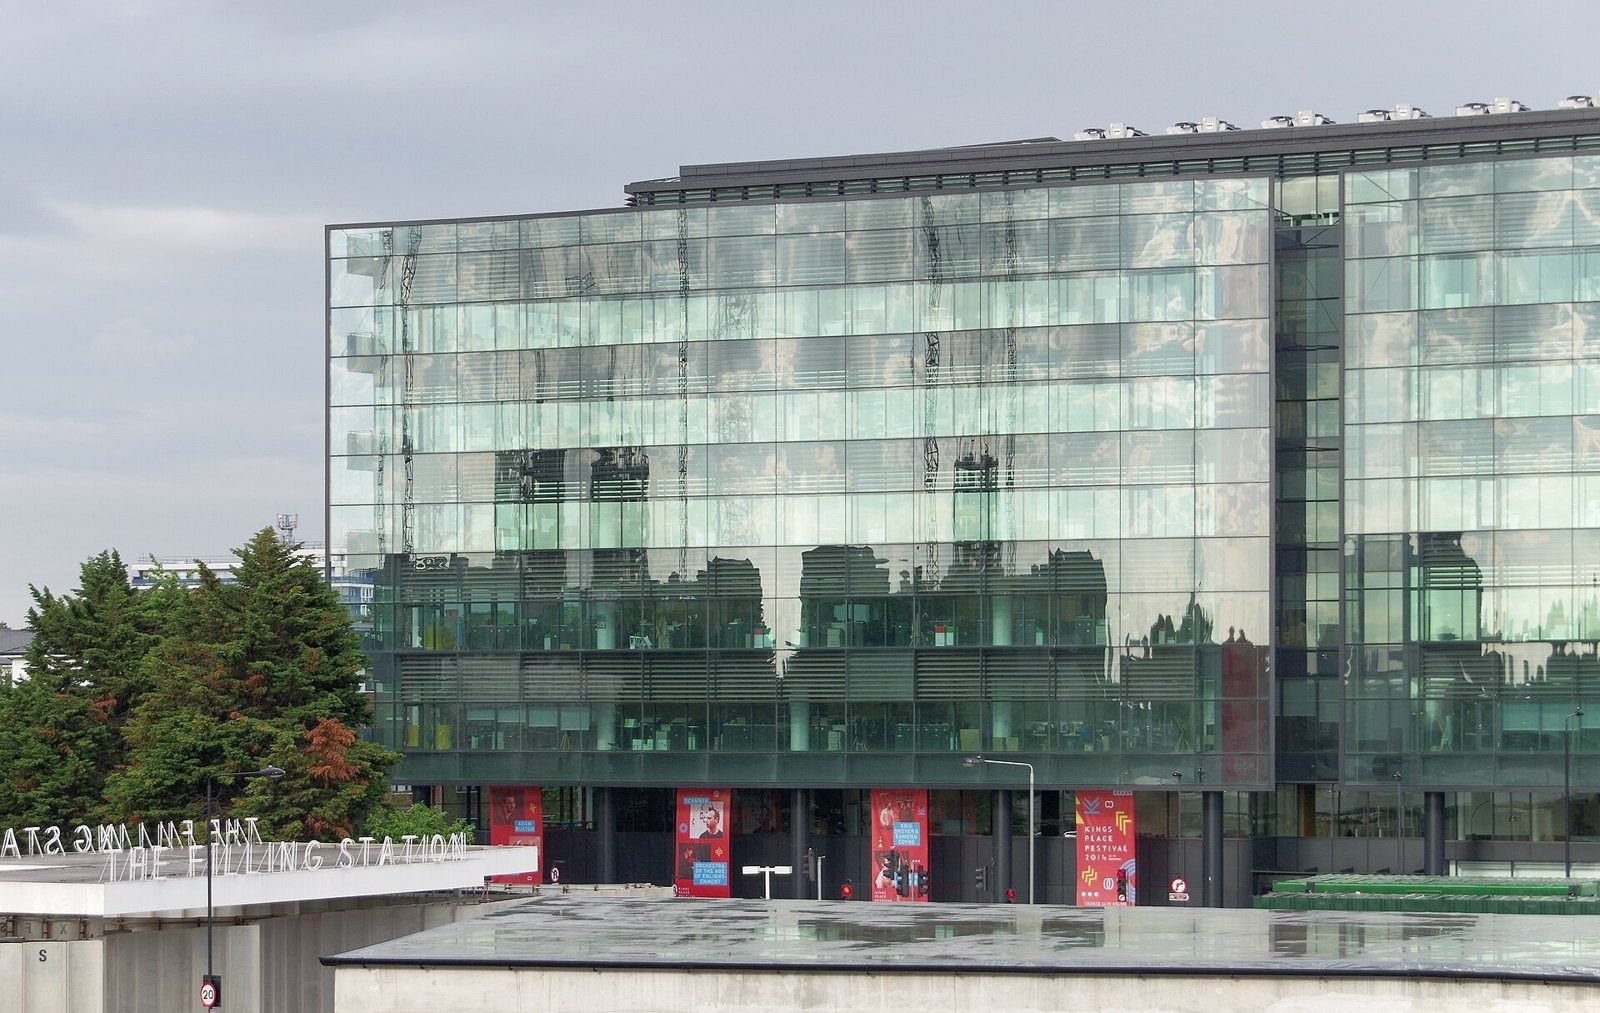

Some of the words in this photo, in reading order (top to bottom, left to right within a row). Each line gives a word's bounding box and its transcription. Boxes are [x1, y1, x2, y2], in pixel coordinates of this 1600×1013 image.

[103, 845, 170, 882] THE
[339, 832, 467, 868] STATION
[203, 989, 214, 1000] 20
